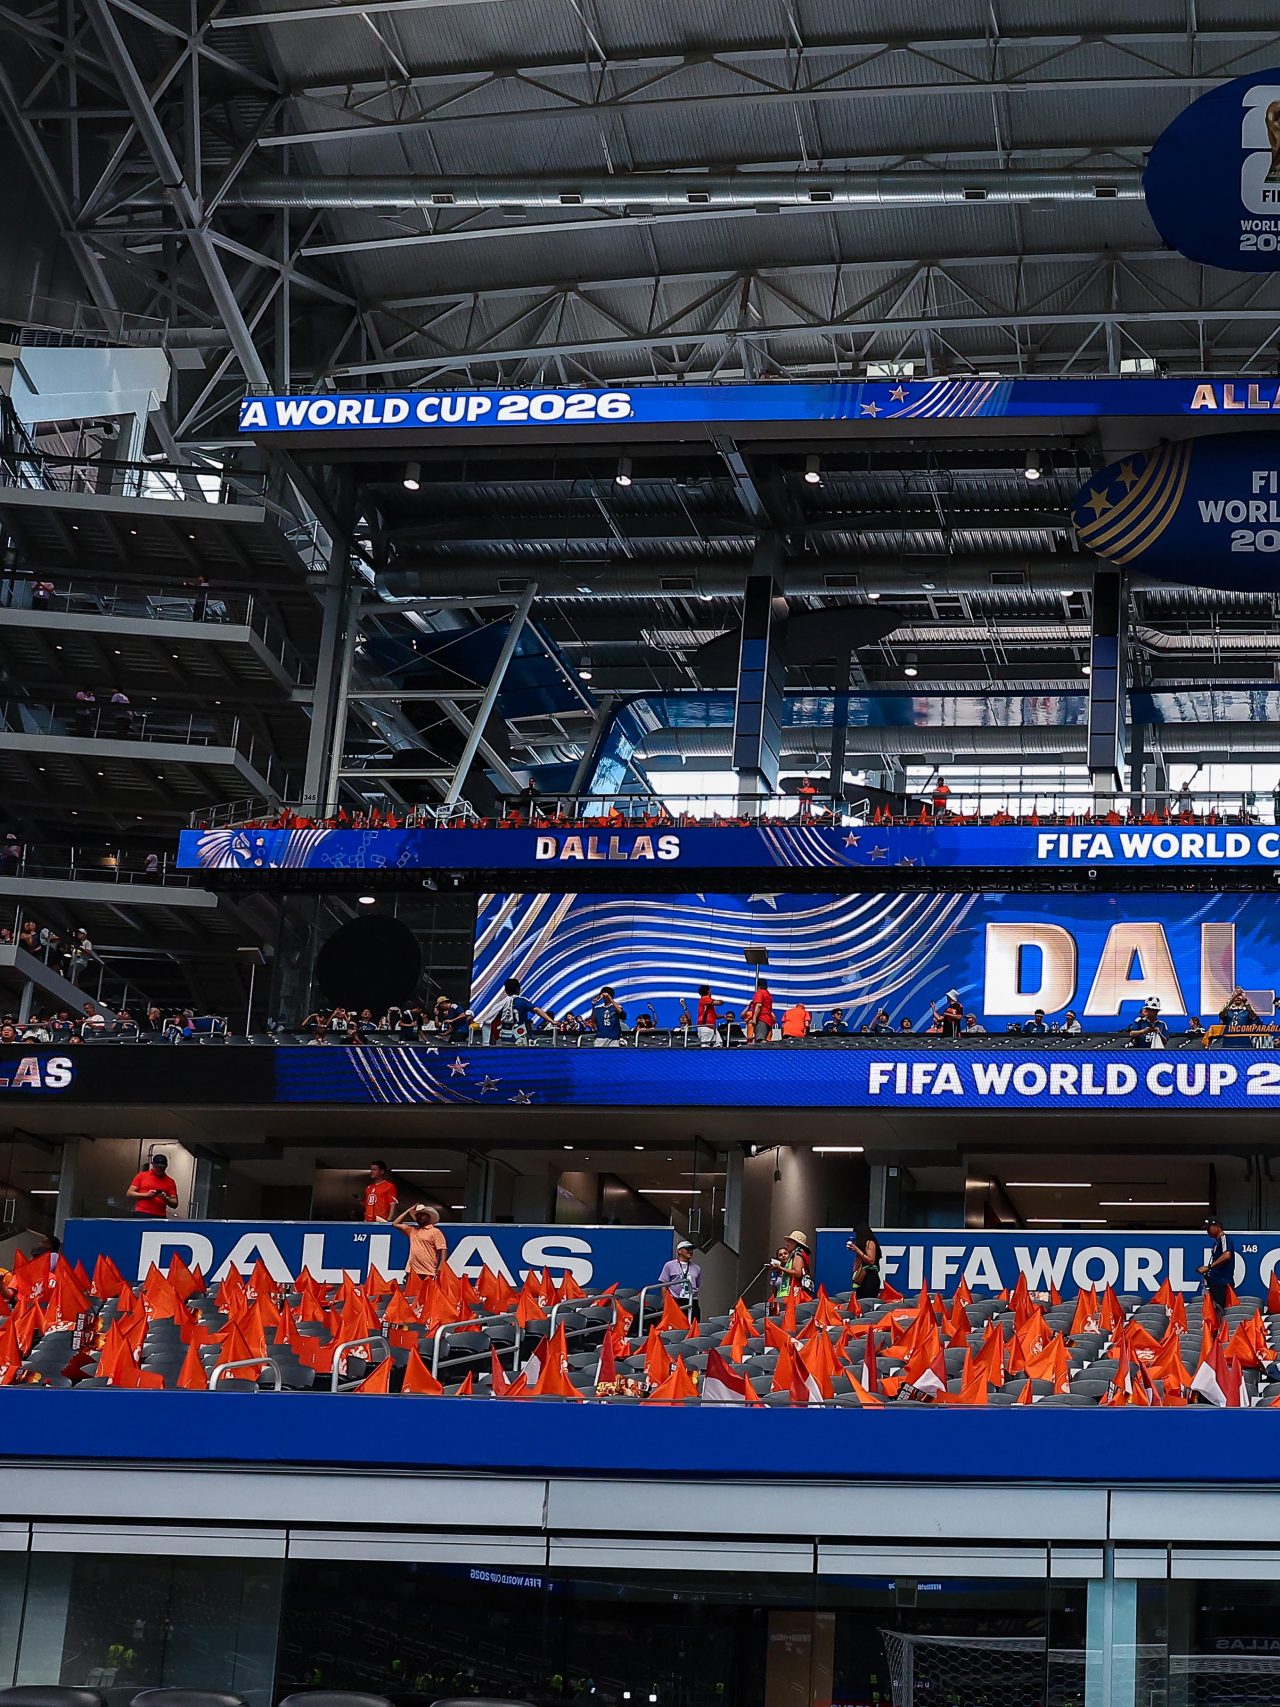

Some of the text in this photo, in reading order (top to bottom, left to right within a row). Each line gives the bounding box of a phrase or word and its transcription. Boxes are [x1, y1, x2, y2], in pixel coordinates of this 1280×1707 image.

[276, 399, 409, 426] WORLD
[416, 396, 490, 423] CUP
[497, 393, 632, 420] 2026
[535, 835, 680, 860] DALLAS
[1037, 833, 1114, 859] FIFA
[1119, 832, 1250, 859] WORLD
[0, 1057, 73, 1088] AS
[868, 1062, 964, 1095] FIFA
[971, 1062, 1138, 1096] WORLD
[1146, 1062, 1238, 1096] CUP
[353, 1233, 367, 1243] 147
[1242, 1244, 1258, 1253] 148
[137, 1231, 593, 1287] DALLAS
[879, 1246, 1003, 1290] FIFA
